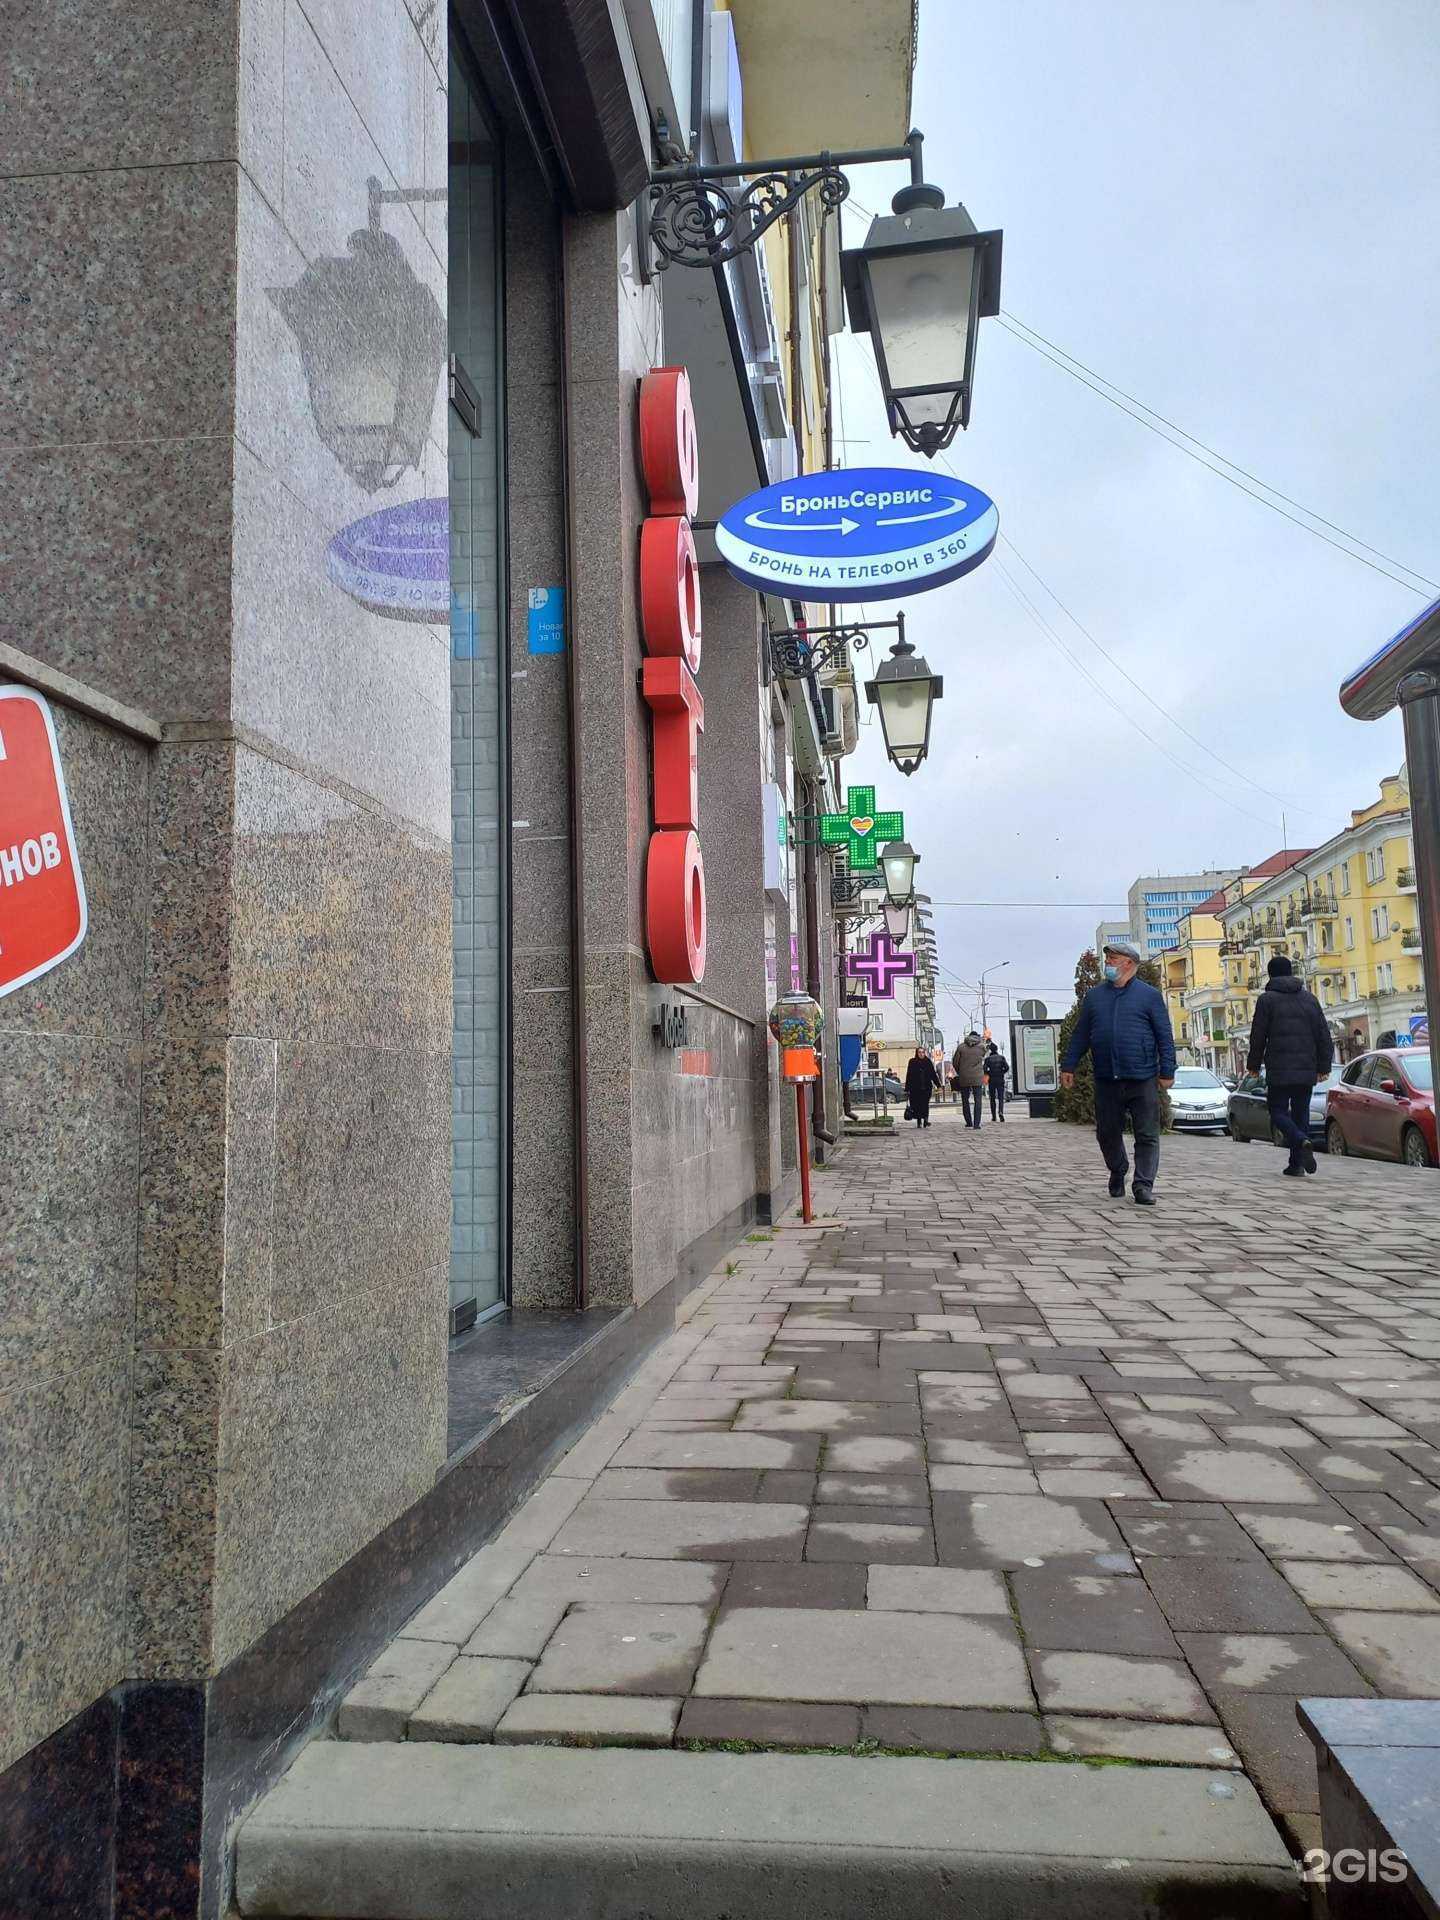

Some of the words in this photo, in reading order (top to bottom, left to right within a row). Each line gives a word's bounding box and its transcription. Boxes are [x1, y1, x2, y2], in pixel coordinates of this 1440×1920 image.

[780, 486, 934, 517] БроньСервис
[748, 551, 804, 577] БРОНЬ
[809, 565, 832, 579] НА
[838, 556, 919, 579] ТЕЛЕФОН
[925, 552, 936, 565] В
[0, 831, 62, 887] НОВ
